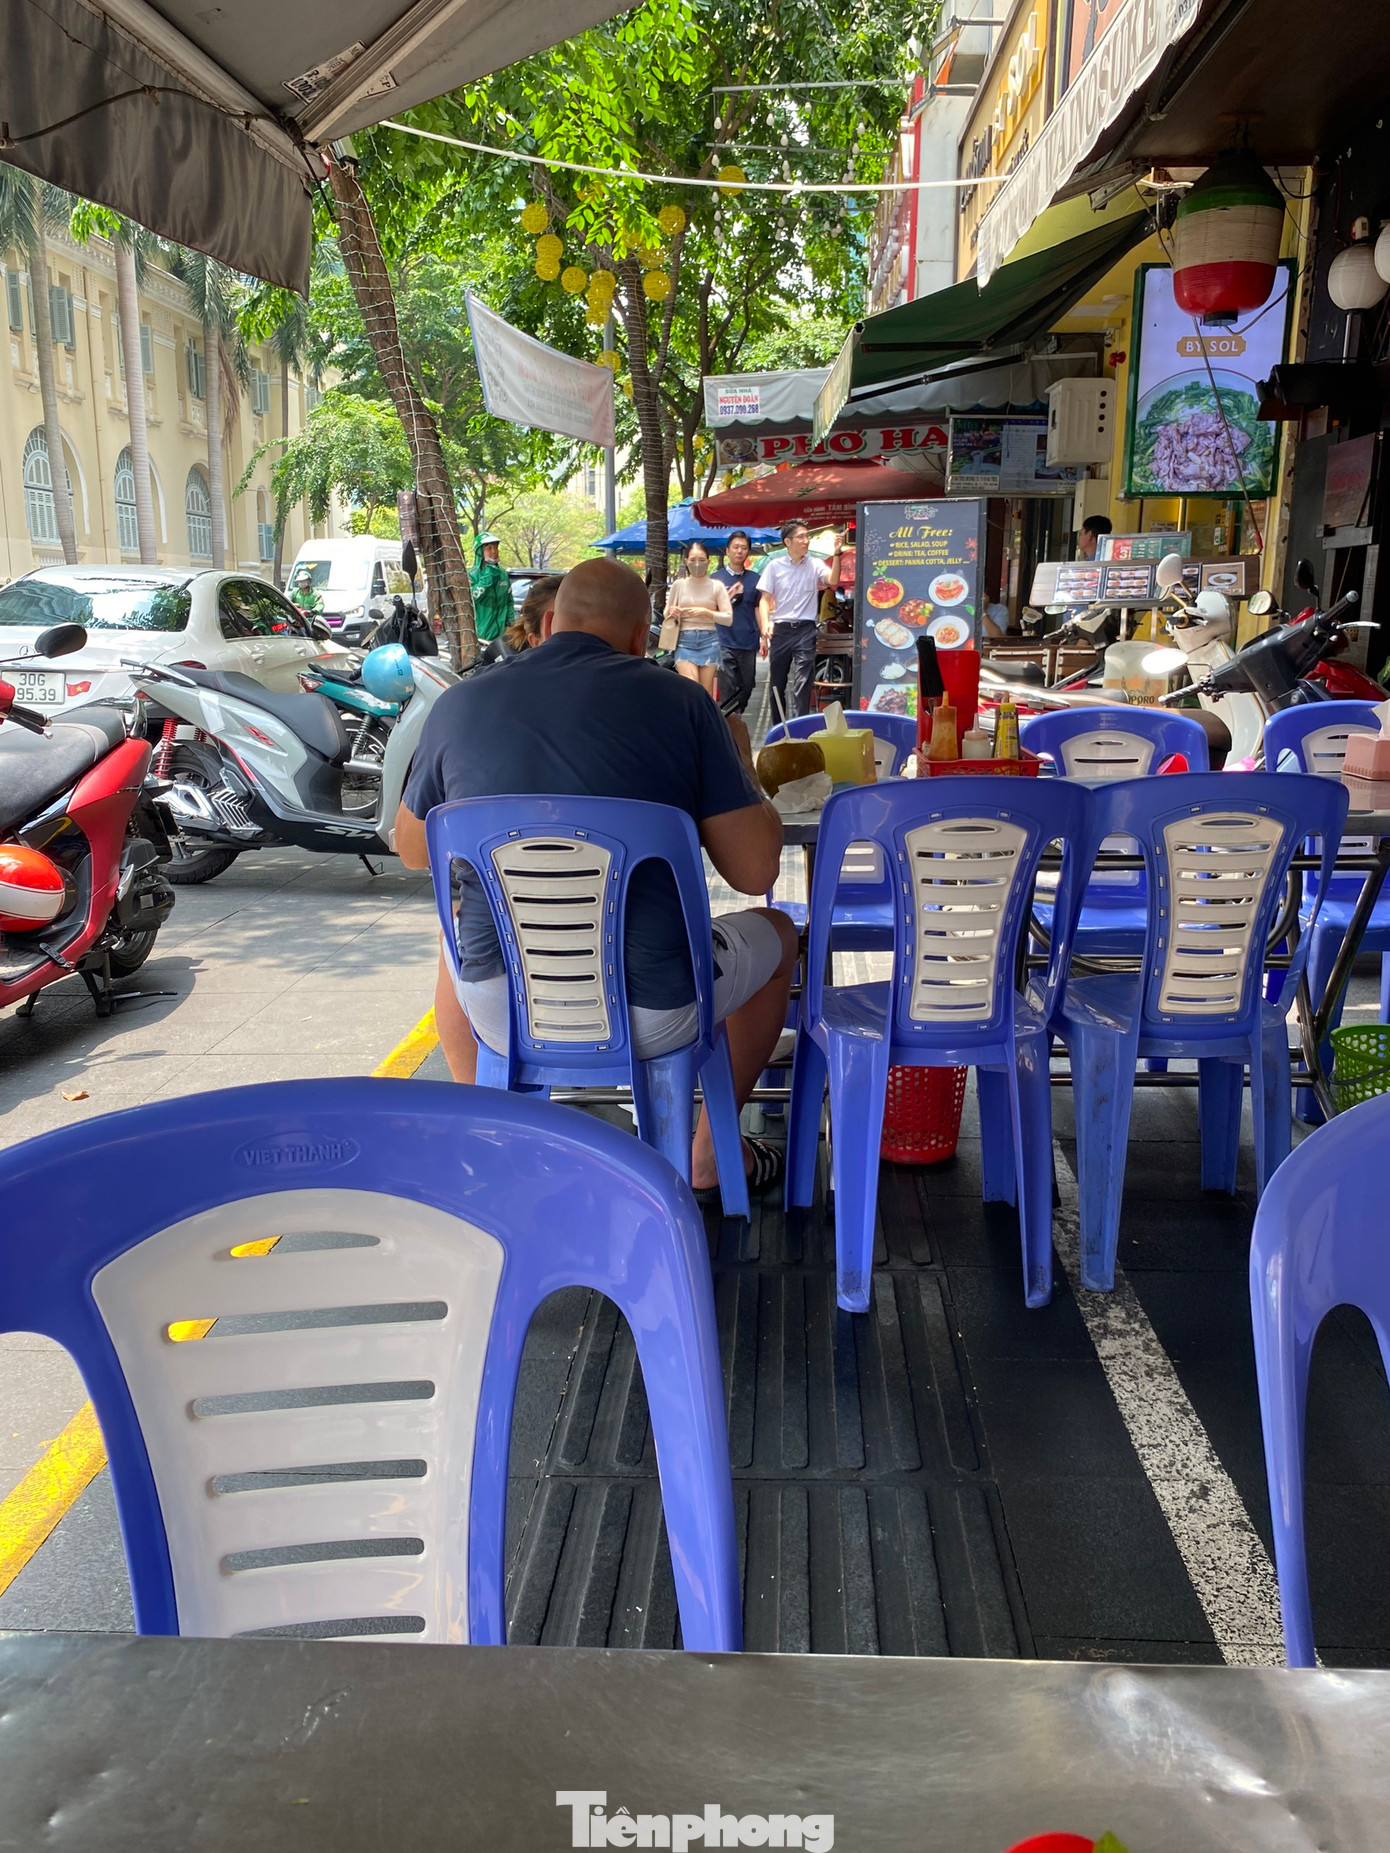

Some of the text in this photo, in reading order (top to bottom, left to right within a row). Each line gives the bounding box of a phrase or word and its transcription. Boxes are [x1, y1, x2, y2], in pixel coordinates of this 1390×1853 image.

[1186, 340, 1239, 352] BY SOL
[889, 525, 953, 539] All Free:
[932, 540, 948, 548] SOUP
[19, 673, 46, 686] 30G
[16, 687, 56, 701] 95.39
